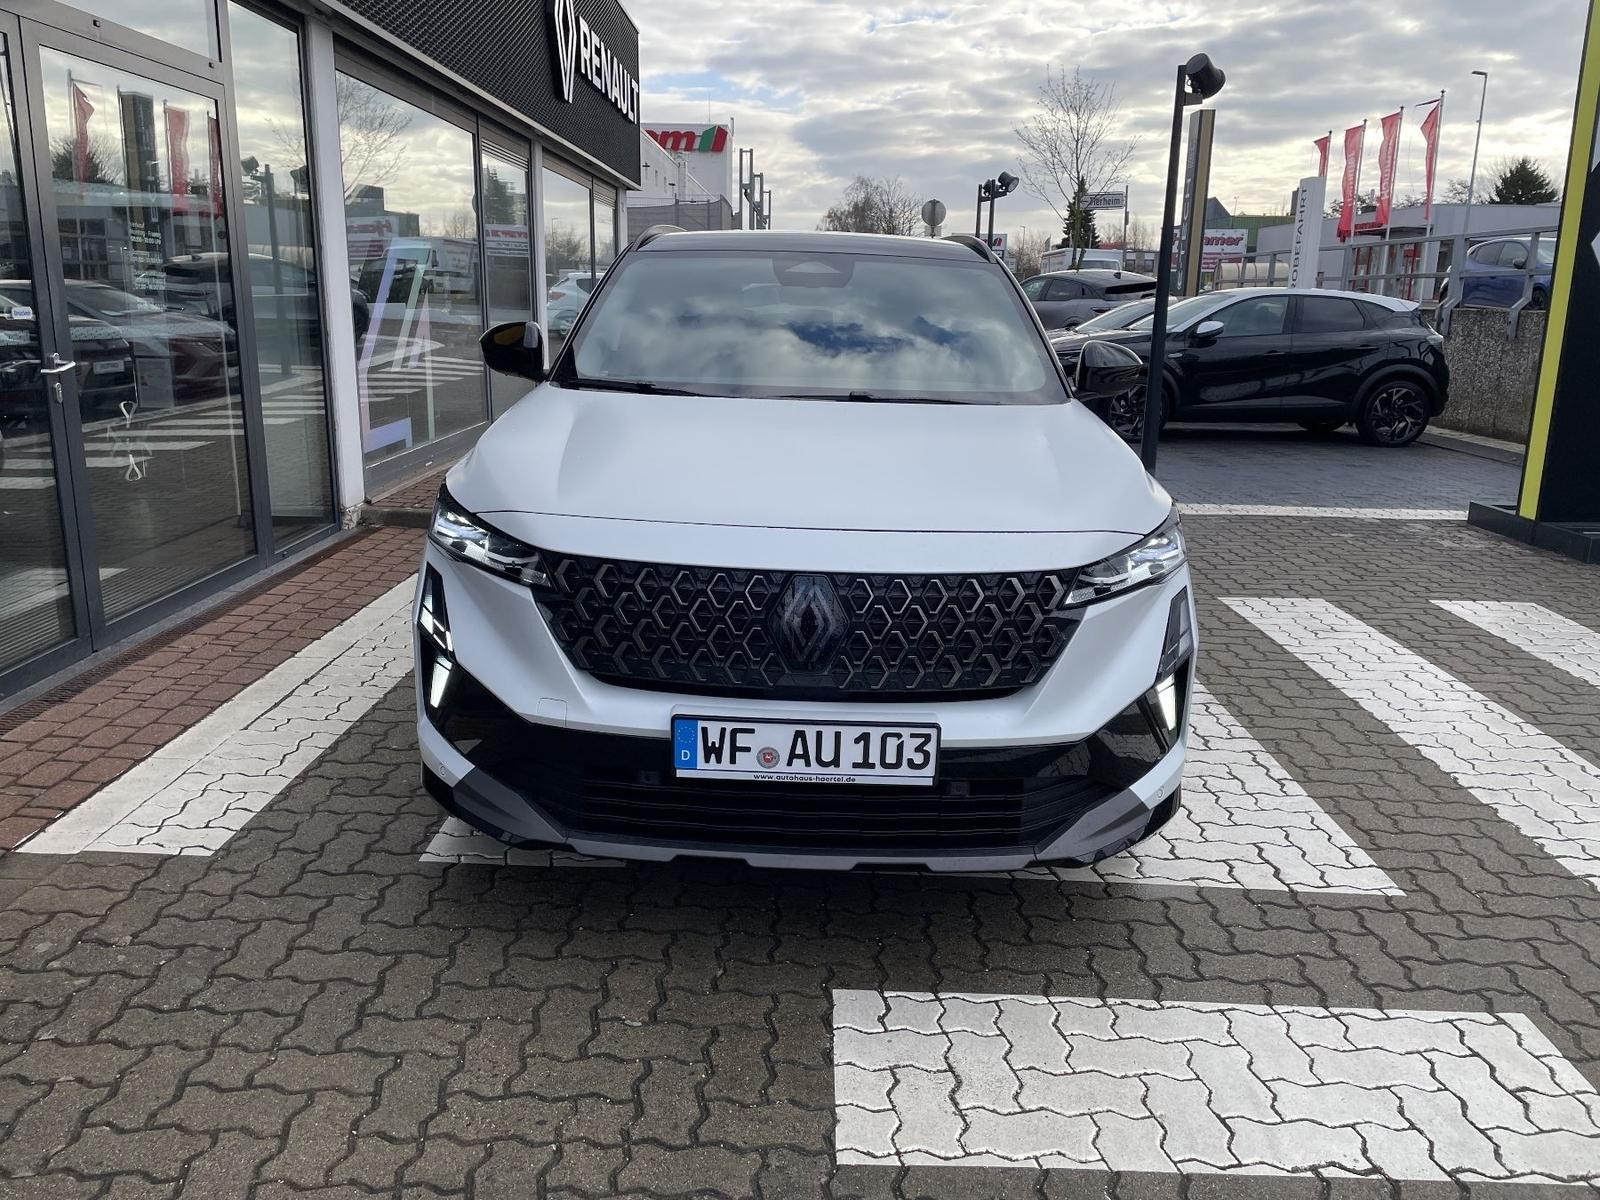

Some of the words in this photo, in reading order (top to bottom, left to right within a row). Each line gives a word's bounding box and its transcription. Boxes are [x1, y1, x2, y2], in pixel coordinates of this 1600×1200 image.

[579, 15, 639, 125] RENAULT
[681, 749, 691, 761] D
[701, 726, 755, 764] WF
[786, 729, 842, 768] AU
[852, 731, 932, 770] 103
[753, 773, 856, 783] www.autohaus-haertel.de
